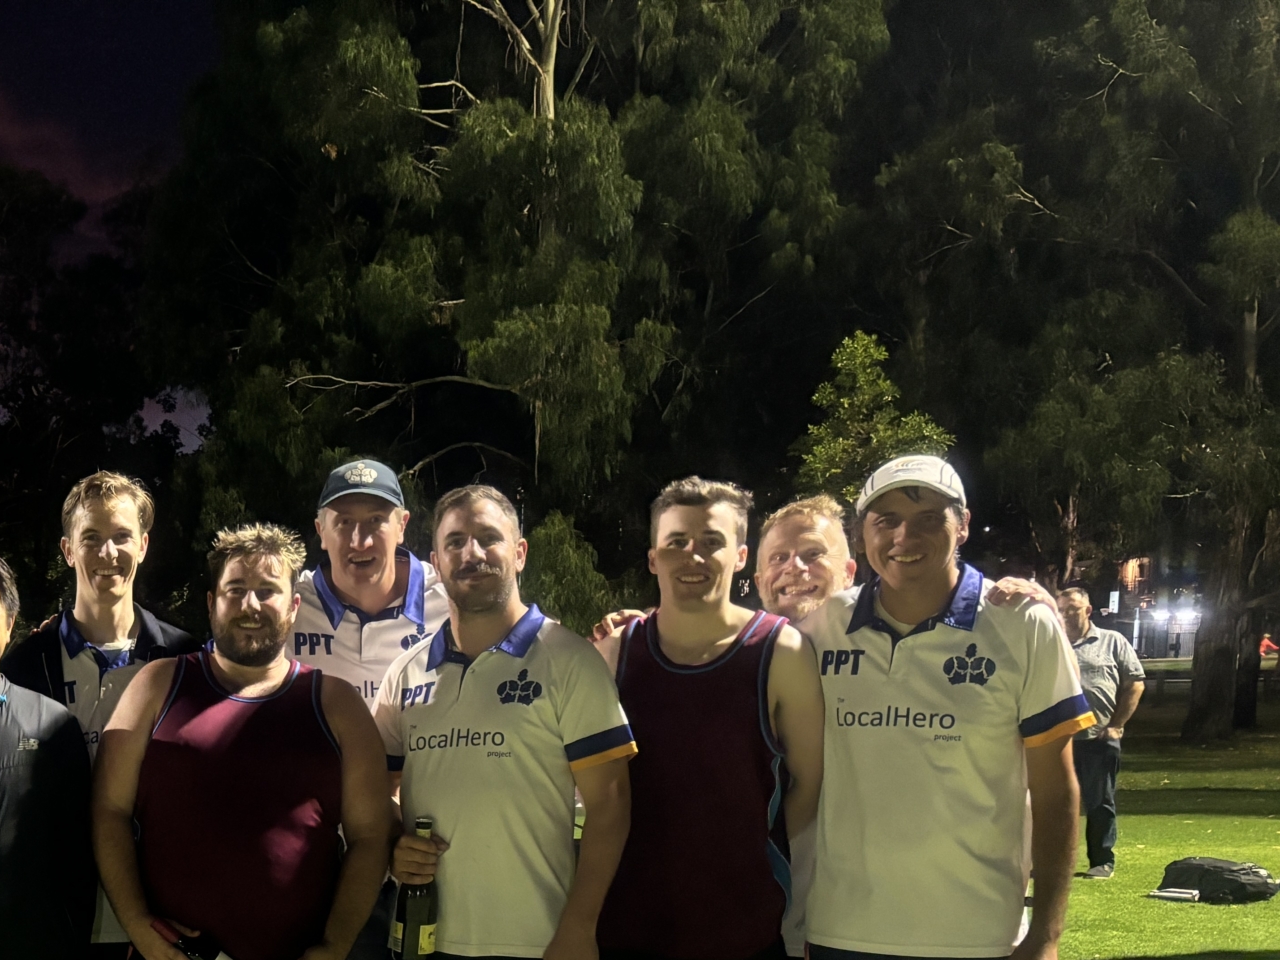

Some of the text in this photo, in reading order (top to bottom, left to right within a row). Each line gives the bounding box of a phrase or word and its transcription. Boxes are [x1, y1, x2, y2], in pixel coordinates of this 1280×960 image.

[294, 632, 335, 656] PPT
[821, 649, 865, 676] PPT
[401, 681, 436, 712] PPT
[836, 705, 956, 729] LocalHero
[408, 728, 505, 752] LocalHero
[933, 733, 962, 742] project
[486, 750, 512, 758] project
